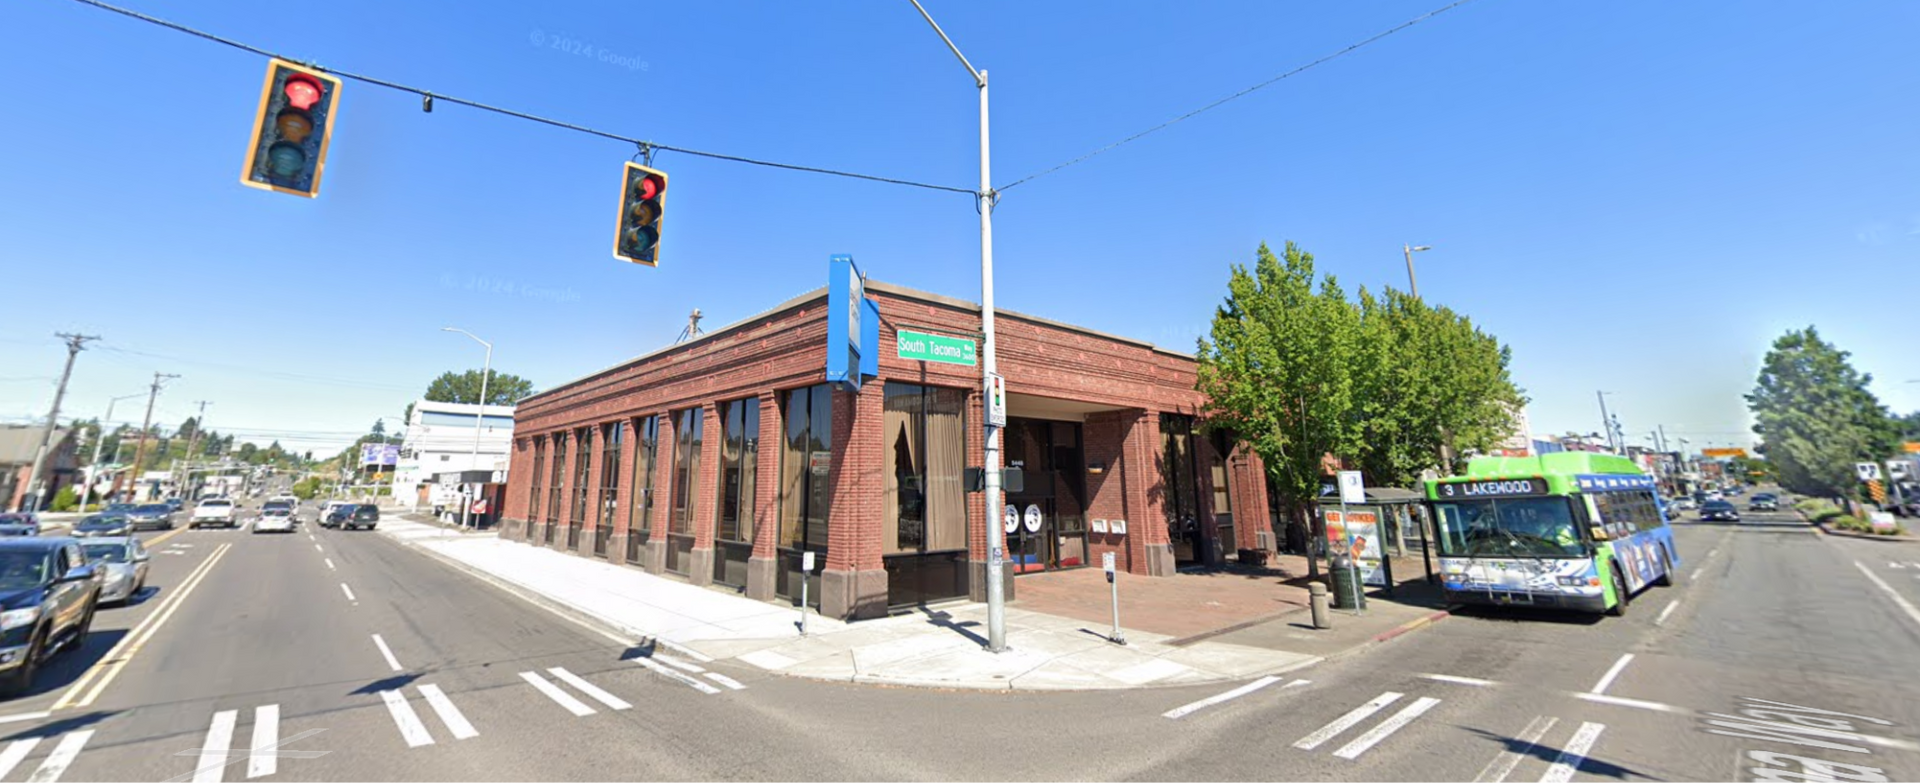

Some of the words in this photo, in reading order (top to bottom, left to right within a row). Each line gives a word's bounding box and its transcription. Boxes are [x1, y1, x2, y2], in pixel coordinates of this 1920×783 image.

[900, 337, 926, 353] South
[929, 341, 961, 358] Tacoma
[1444, 484, 1454, 496] 3
[1462, 480, 1532, 496] LAKEWOOD
